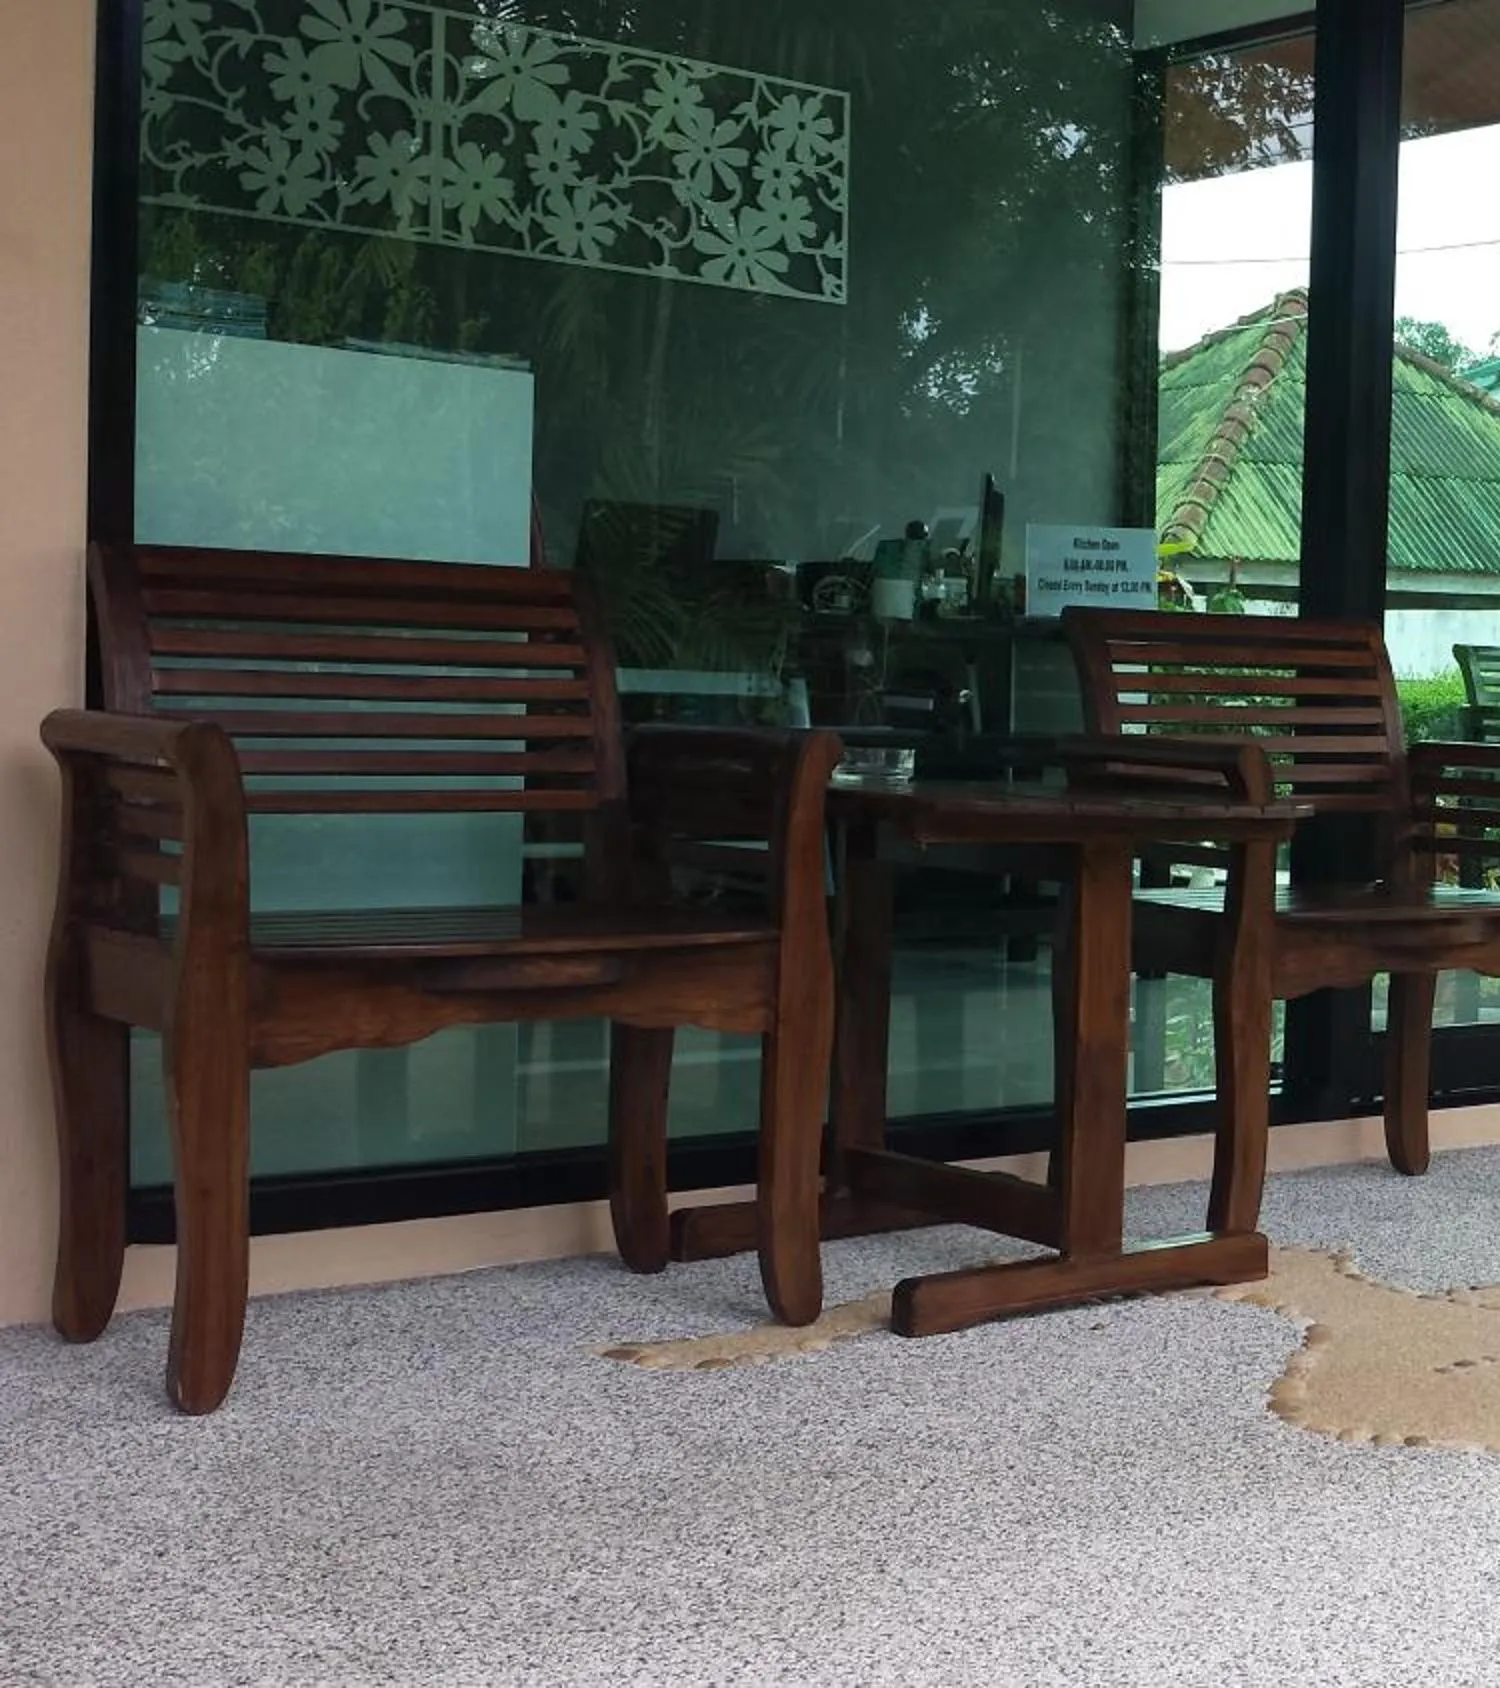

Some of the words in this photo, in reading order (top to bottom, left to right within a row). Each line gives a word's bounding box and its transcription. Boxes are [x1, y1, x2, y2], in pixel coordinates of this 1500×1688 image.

[1073, 537, 1100, 550] Kitchen
[1102, 538, 1120, 552] Open
[1037, 577, 1062, 592] Closed
